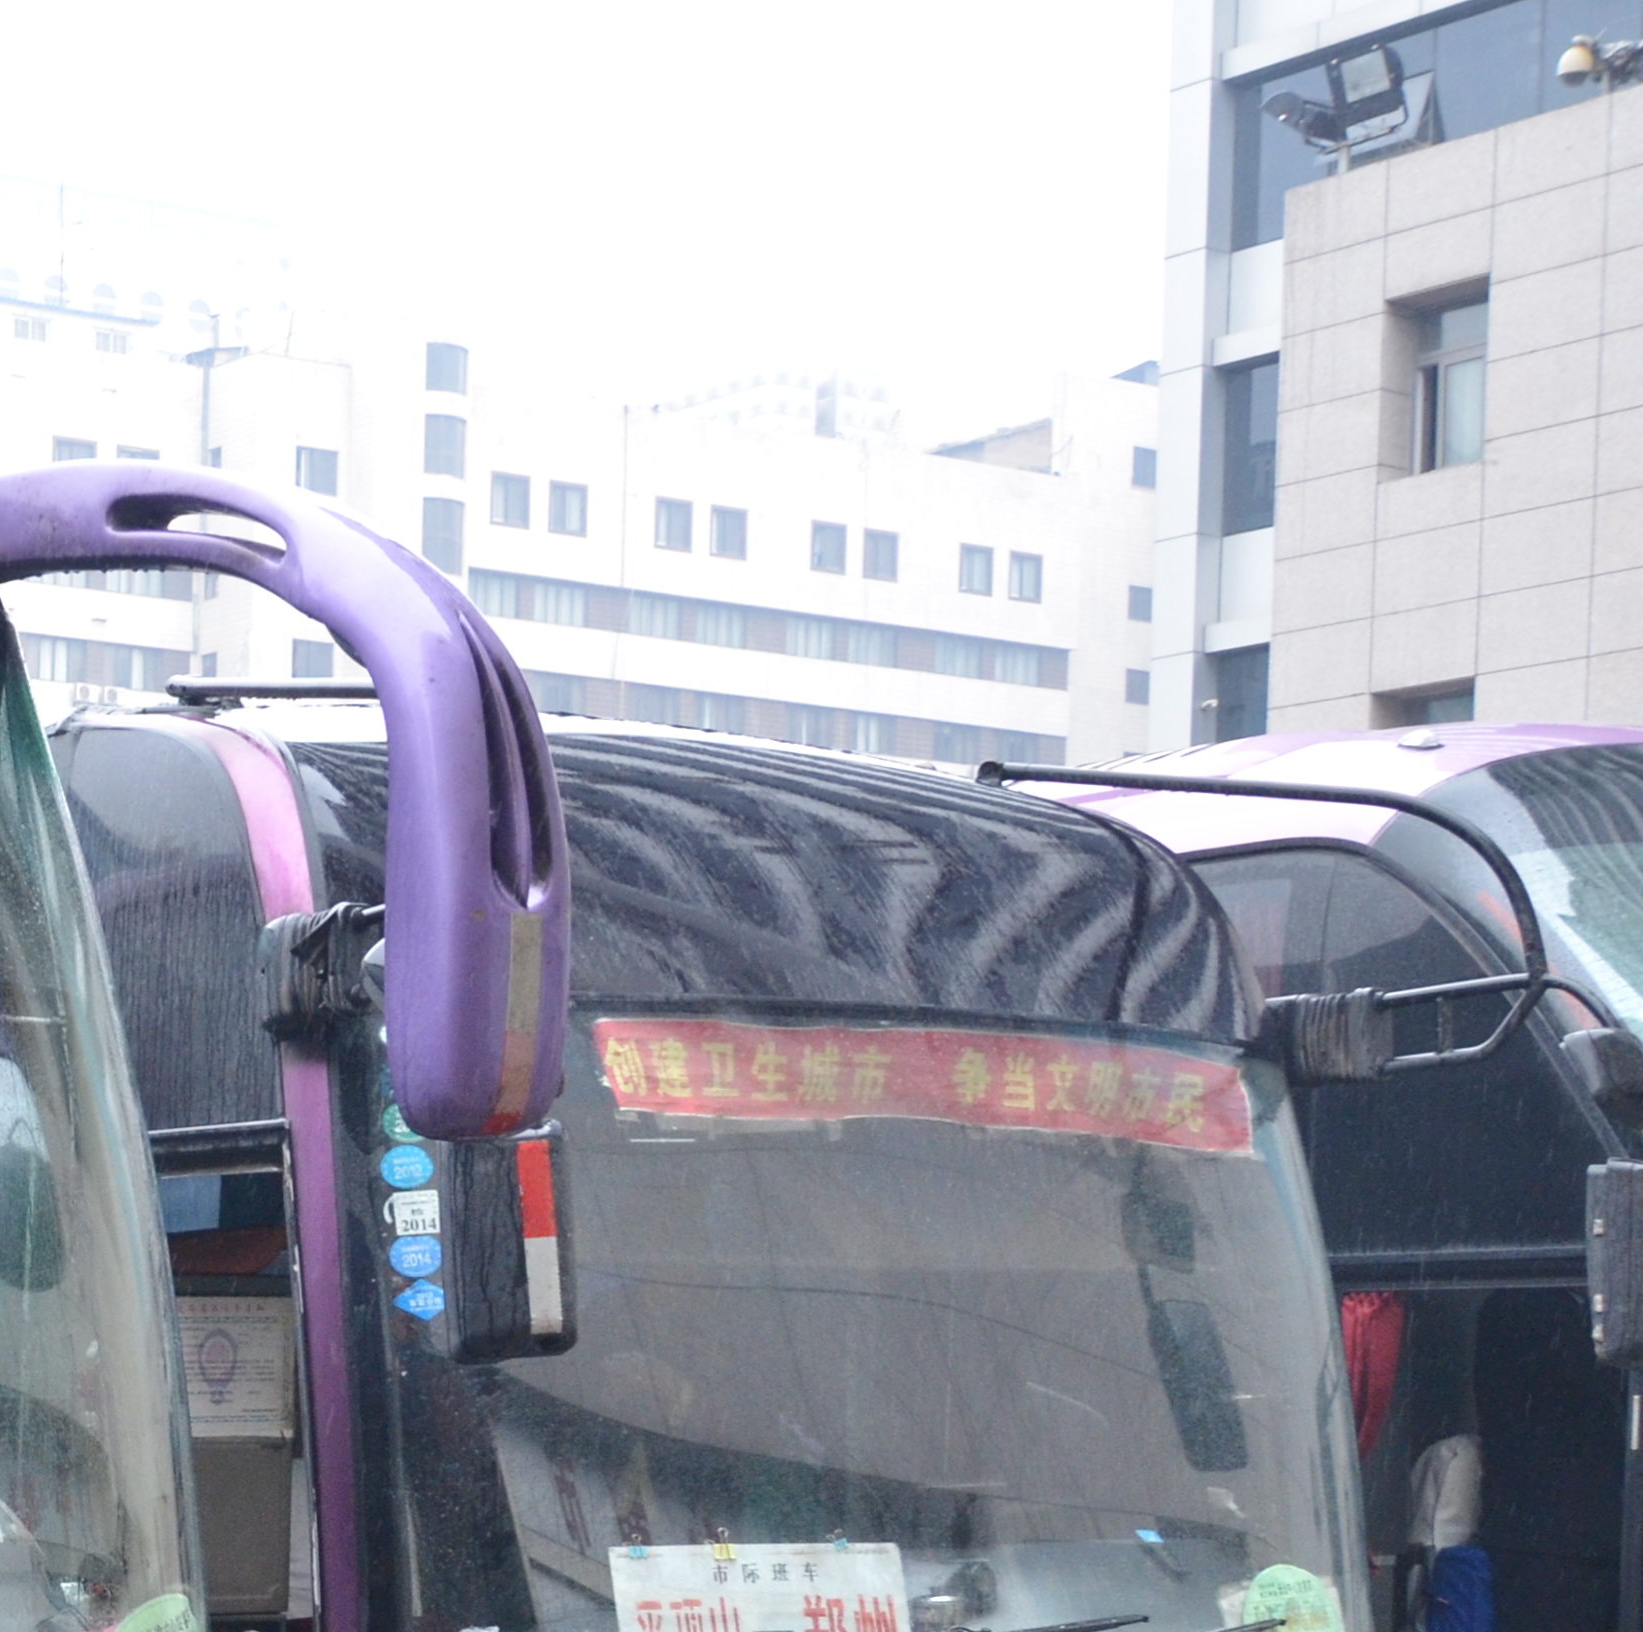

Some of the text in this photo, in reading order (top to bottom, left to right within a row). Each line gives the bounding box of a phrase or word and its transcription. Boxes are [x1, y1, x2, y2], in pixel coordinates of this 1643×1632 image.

[602, 1035, 1207, 1133] 创建卫生城市 争当文明市民
[400, 1217, 438, 1233] 2014
[402, 1252, 433, 1268] 2014
[712, 1561, 819, 1584] 市际班车
